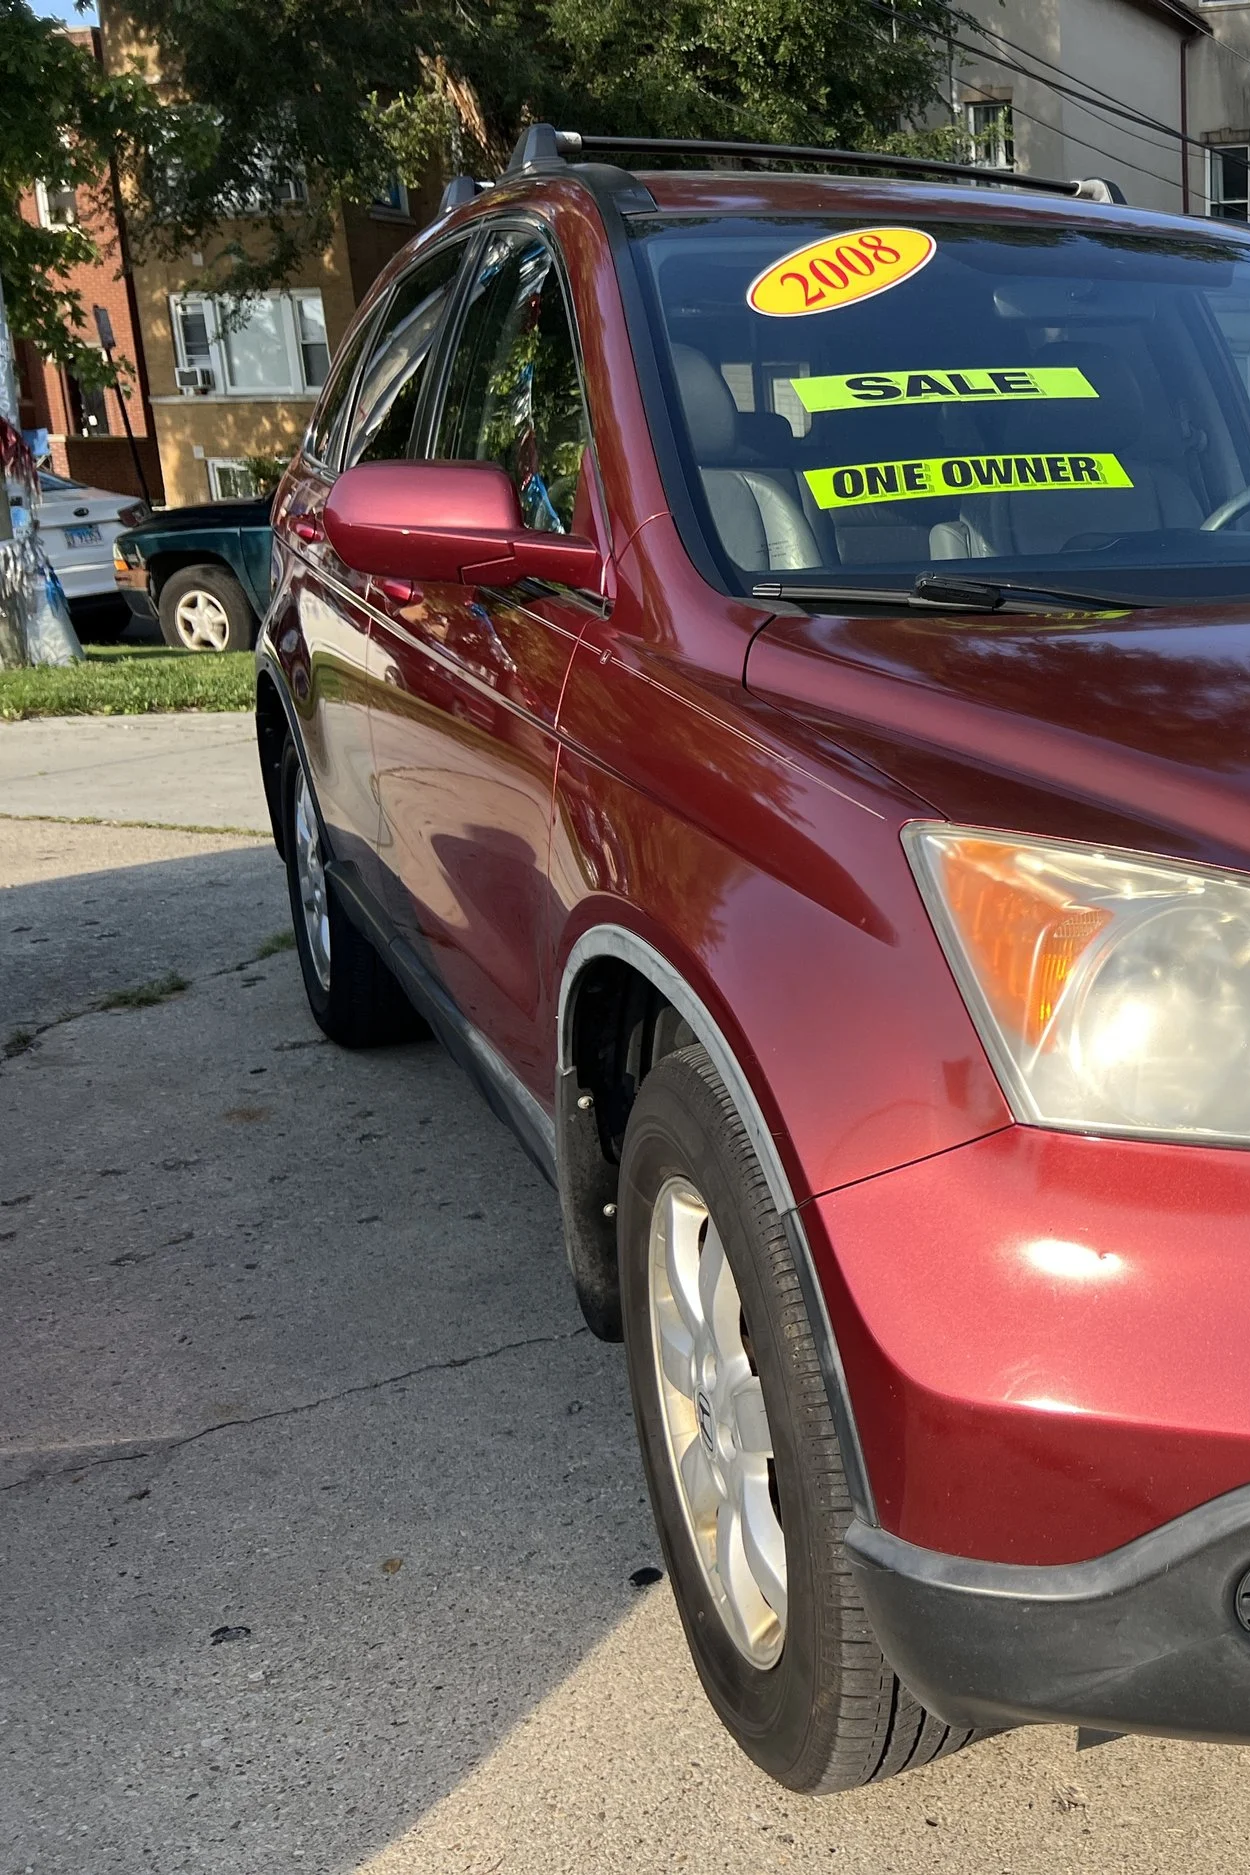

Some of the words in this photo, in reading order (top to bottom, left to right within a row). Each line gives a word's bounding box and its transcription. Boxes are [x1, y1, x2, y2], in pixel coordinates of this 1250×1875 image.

[780, 234, 900, 307] 2008
[845, 371, 1042, 401] SALE
[832, 463, 932, 499] ONE
[941, 456, 1103, 488] OWNER
